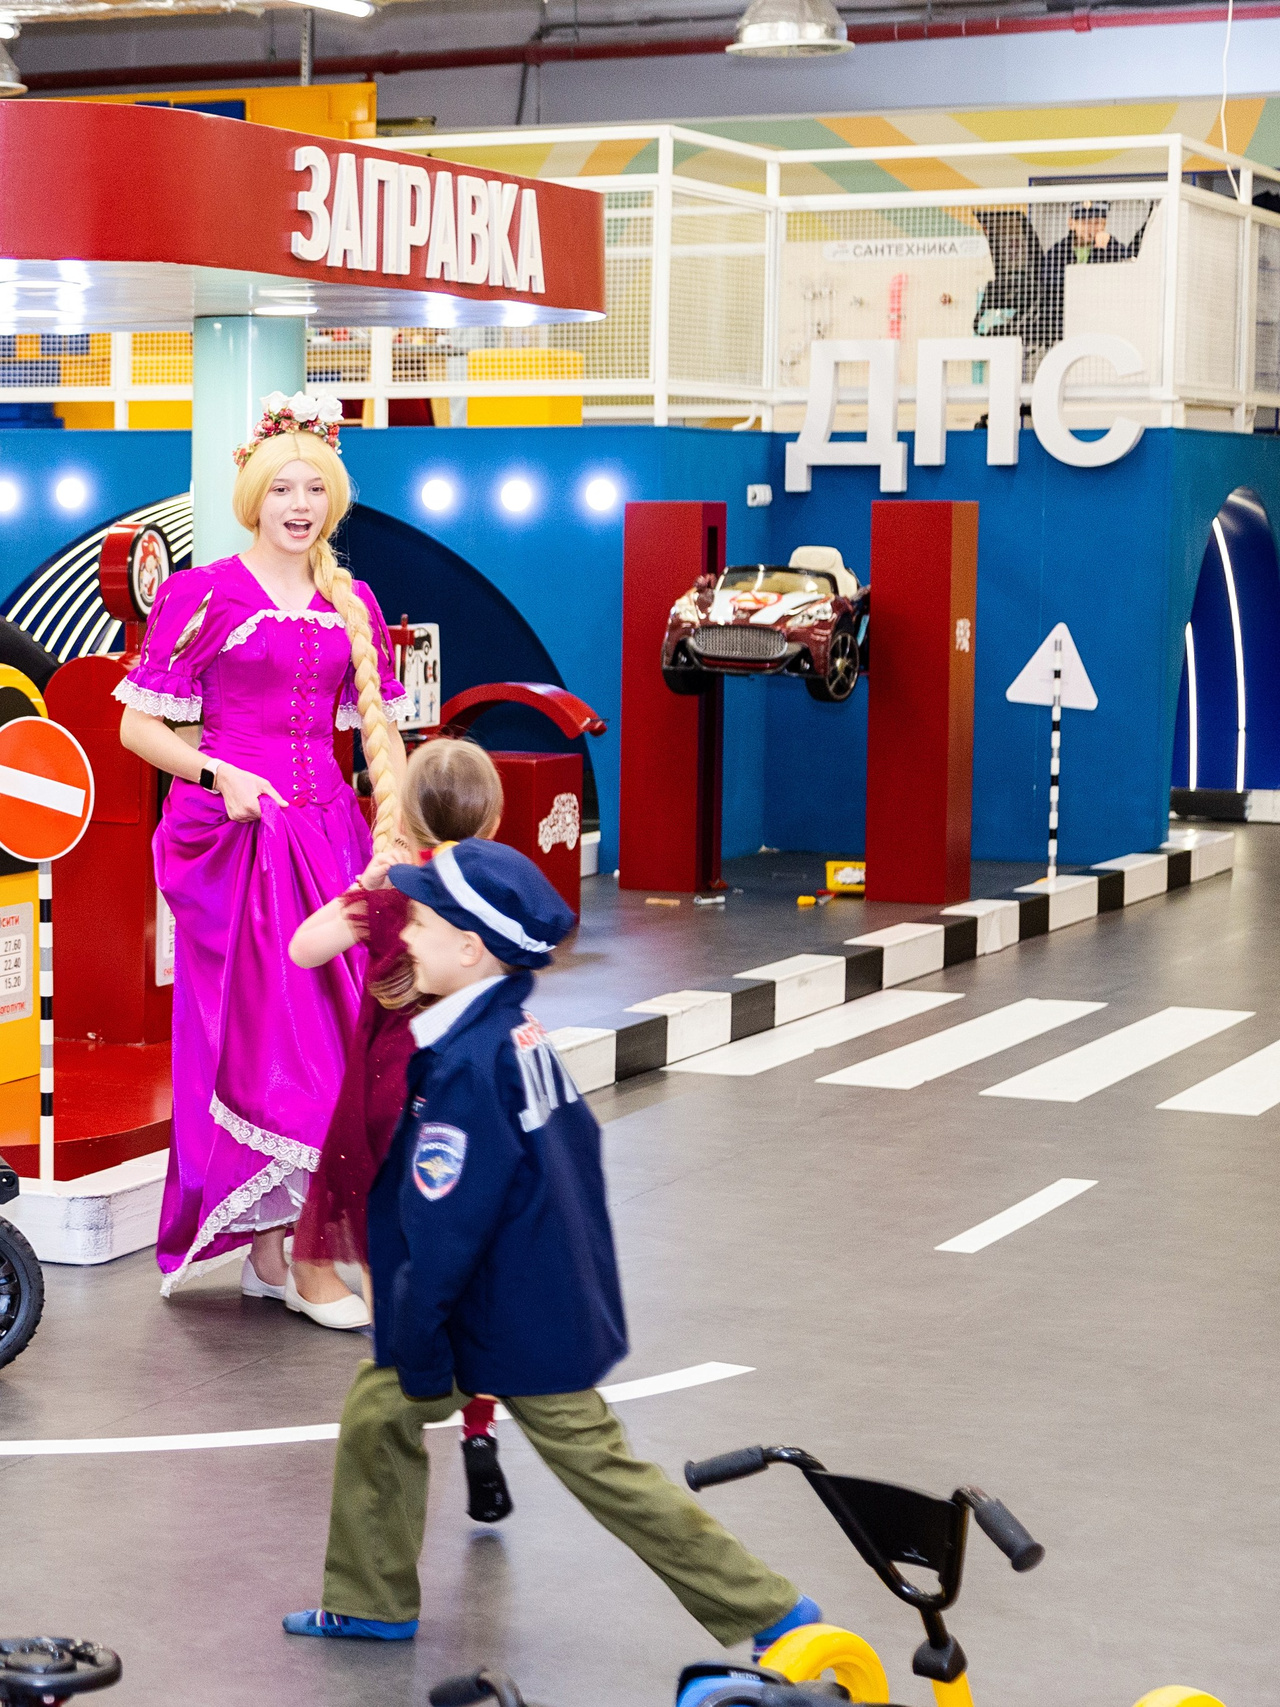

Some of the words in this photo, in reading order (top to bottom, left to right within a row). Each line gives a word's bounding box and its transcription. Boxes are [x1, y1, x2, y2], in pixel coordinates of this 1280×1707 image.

[290, 145, 546, 294] ЗАПРАВКА
[852, 241, 959, 258] САНТЕХНИКА
[784, 333, 1146, 493] ДПС
[3, 938, 22, 953] 27.60
[3, 957, 22, 971] 22.40
[4, 976, 22, 990] 15.20
